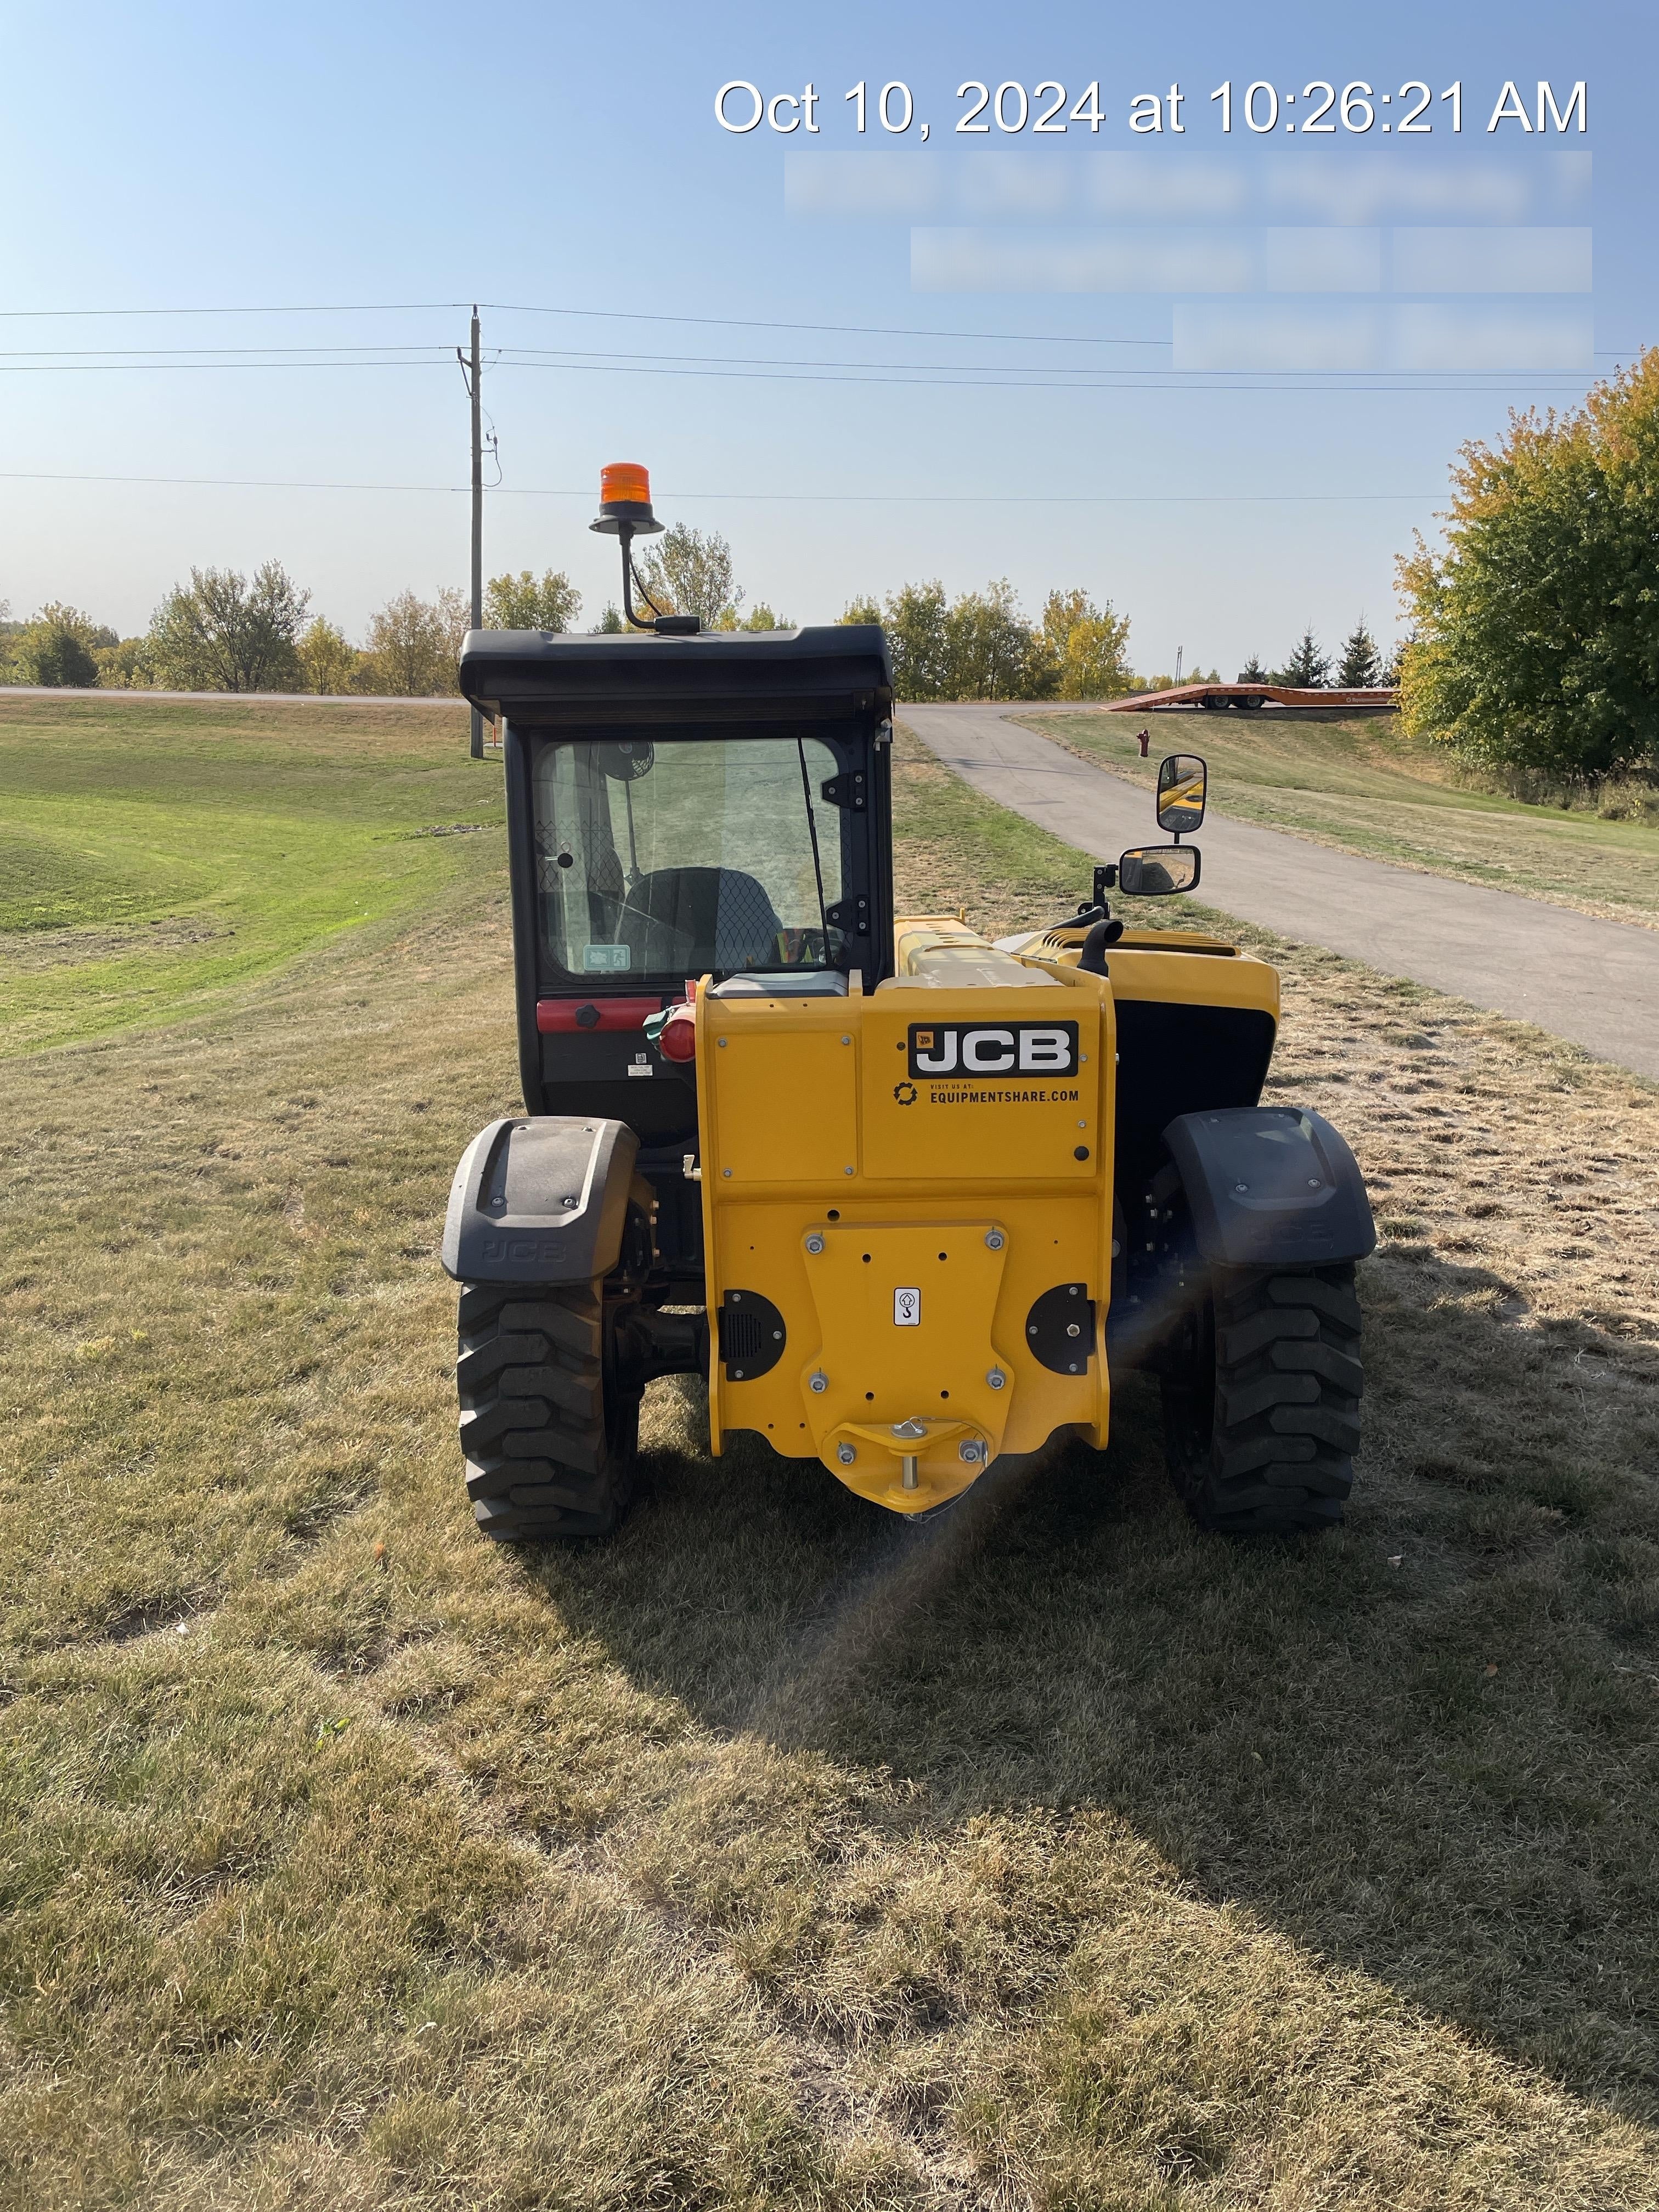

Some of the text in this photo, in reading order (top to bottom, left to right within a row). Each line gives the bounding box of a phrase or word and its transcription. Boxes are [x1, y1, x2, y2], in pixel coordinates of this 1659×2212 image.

[916, 1030, 1071, 1071] JCB
[931, 1091, 1079, 1104] EQUIPMENTSHARE.COM
[483, 1240, 566, 1262] JCB
